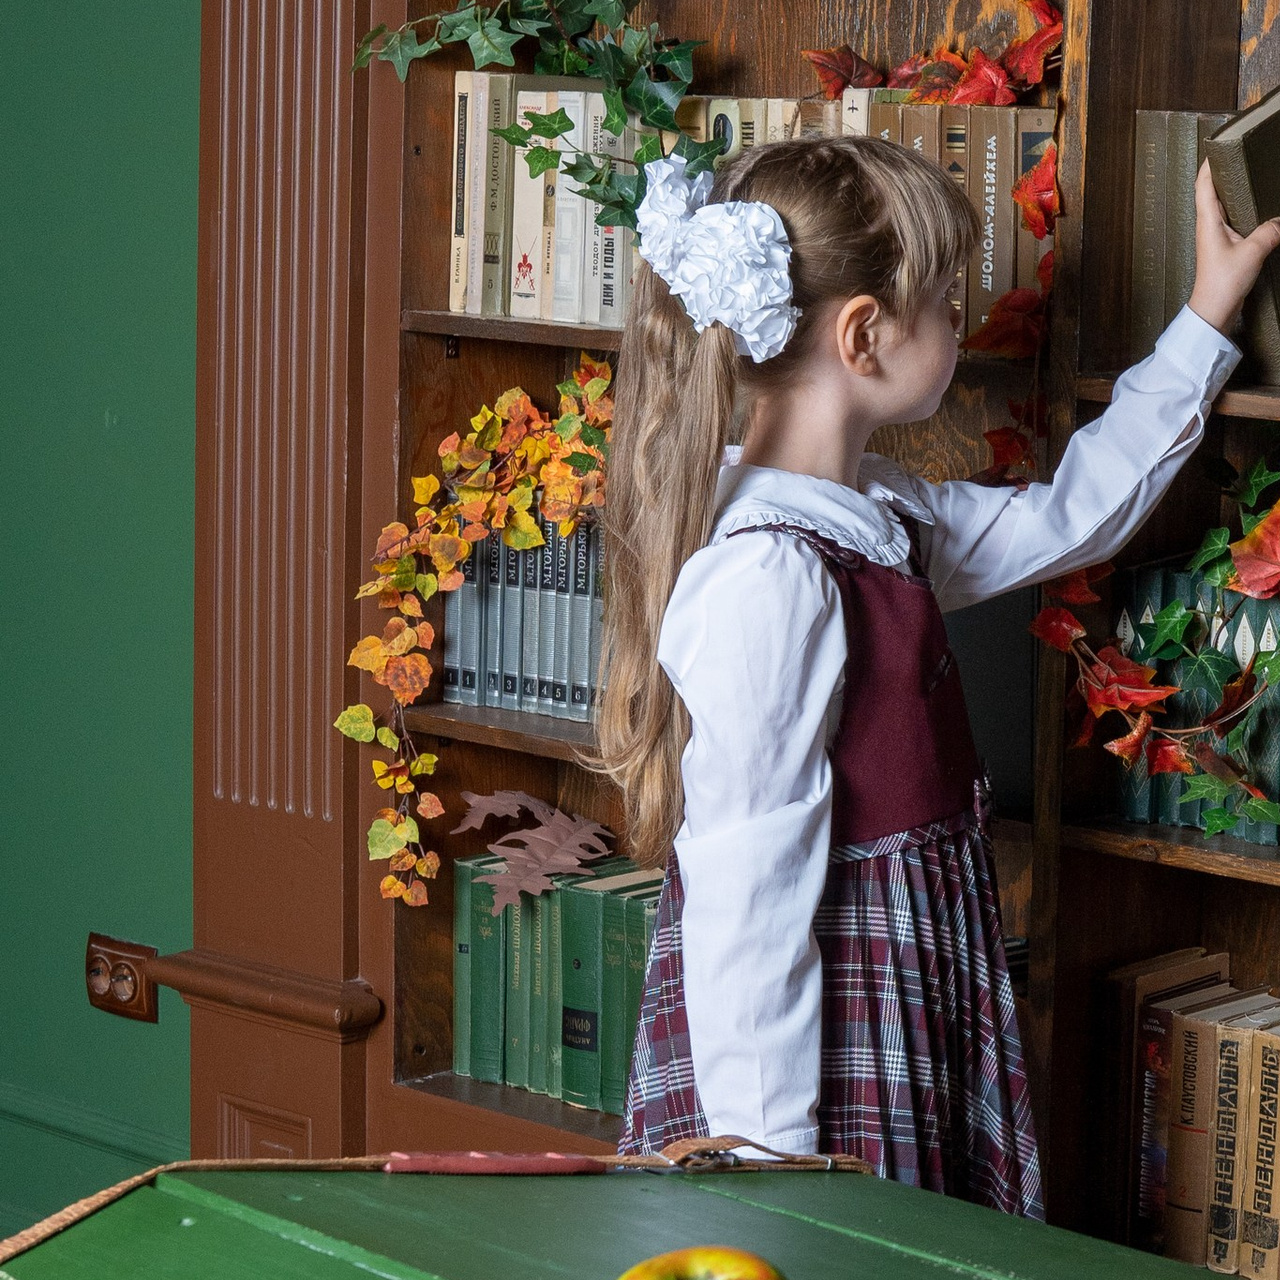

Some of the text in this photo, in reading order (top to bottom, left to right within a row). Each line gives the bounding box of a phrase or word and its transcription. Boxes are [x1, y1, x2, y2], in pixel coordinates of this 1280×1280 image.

[980, 133, 998, 293] ШОЛОМ-АЛЕЙХЕМ
[602, 237, 614, 308] ДНИ И ГОДЫ
[534, 900, 542, 954] ШОЛОХОВ
[1180, 1028, 1198, 1126] К.ПАУСТОВСКИЙ
